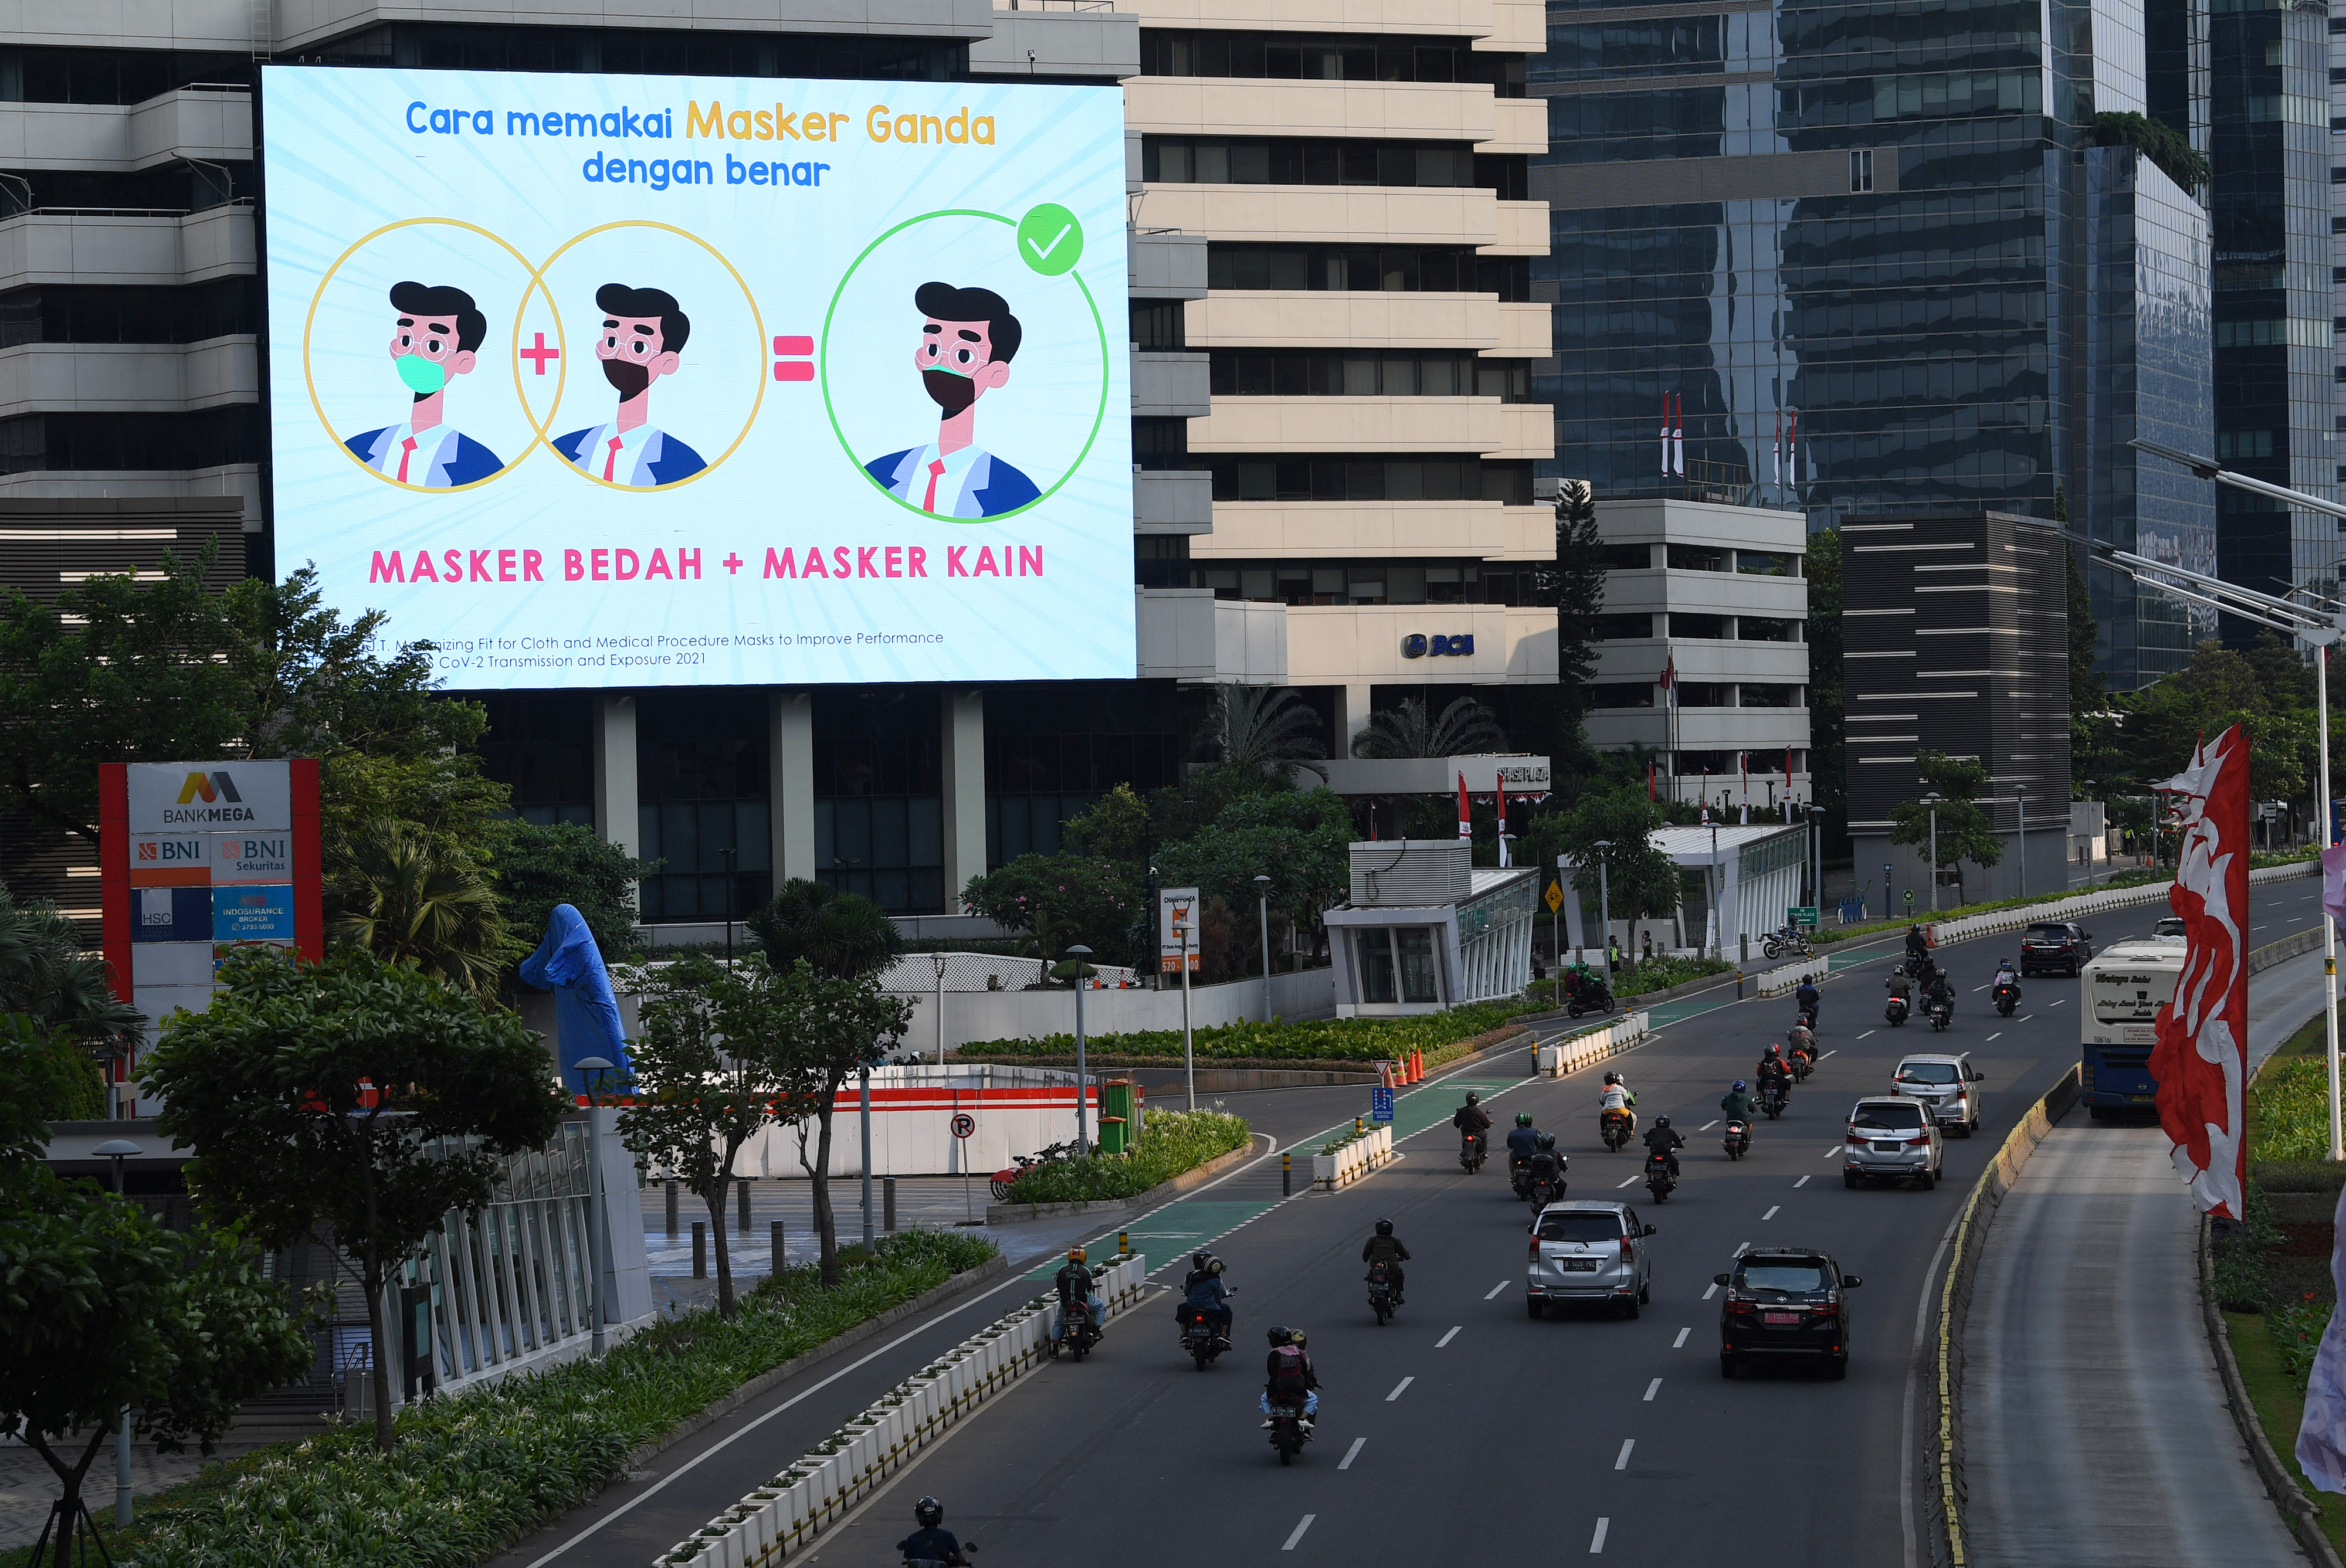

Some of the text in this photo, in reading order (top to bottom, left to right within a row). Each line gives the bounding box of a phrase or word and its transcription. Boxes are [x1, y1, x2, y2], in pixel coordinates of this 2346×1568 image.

[407, 101, 996, 145] Cara memakai Masker Ganda
[584, 151, 832, 192] dengan benar
[369, 549, 544, 584] MASKER
[565, 548, 702, 582] BEDAH
[764, 547, 928, 579] MASKER
[948, 546, 1043, 578] KAIN
[479, 637, 493, 650] Fit
[499, 637, 517, 650] for
[521, 636, 558, 650] Cloth
[564, 636, 591, 649] and
[596, 635, 653, 649] Medical
[657, 634, 729, 647] Procedure
[734, 634, 775, 646] Masks
[779, 634, 792, 646] to
[797, 633, 852, 647] Improve
[857, 632, 944, 645] Performance
[1431, 634, 1474, 656] BCA
[439, 656, 484, 668] CoV-2
[489, 654, 572, 668] Transmission
[578, 654, 605, 667] and
[611, 654, 671, 668] Exposure
[676, 653, 706, 665] 2021
[1525, 767, 1549, 781] PLAZA
[161, 841, 200, 860] BNI
[244, 840, 285, 858] BNI
[236, 861, 285, 871] Sekuritas
[143, 912, 171, 924] HSC
[1162, 961, 1175, 972] 520
